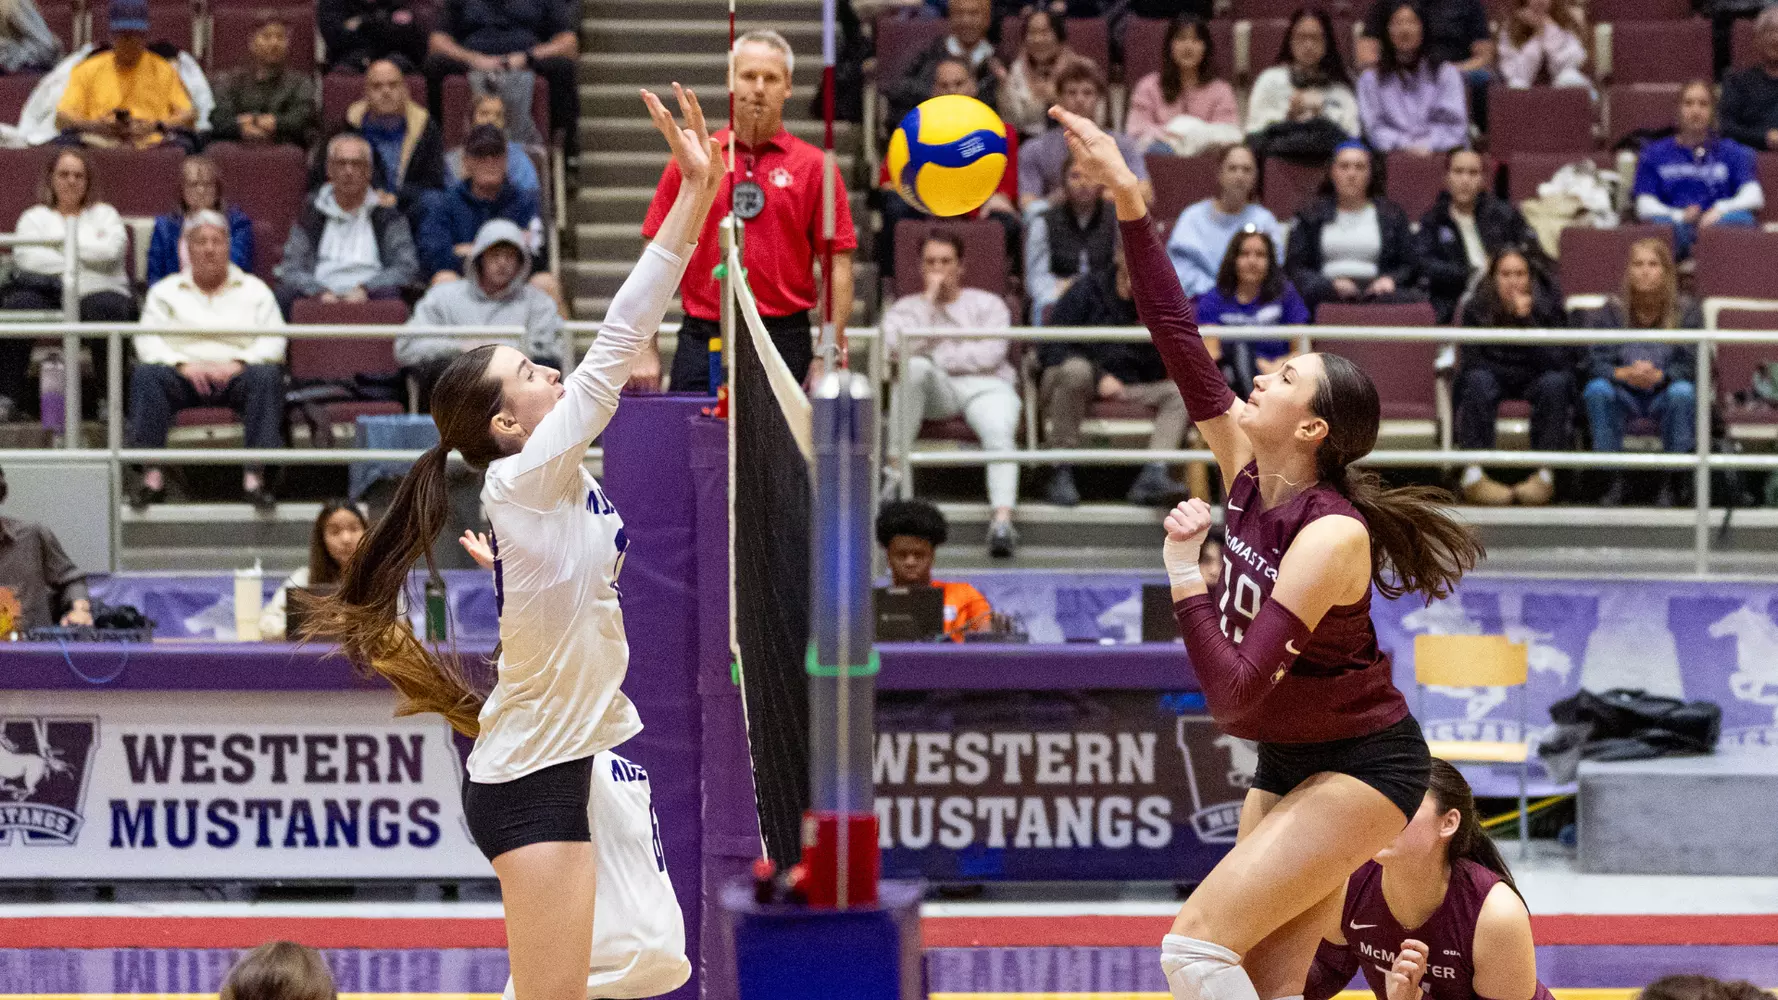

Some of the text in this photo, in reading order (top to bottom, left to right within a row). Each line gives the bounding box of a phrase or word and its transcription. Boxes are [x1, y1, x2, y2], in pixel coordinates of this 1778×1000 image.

[122, 733, 425, 784] WESTERN
[109, 798, 442, 849] MUSTANGS
[1360, 941, 1456, 979] McMER
